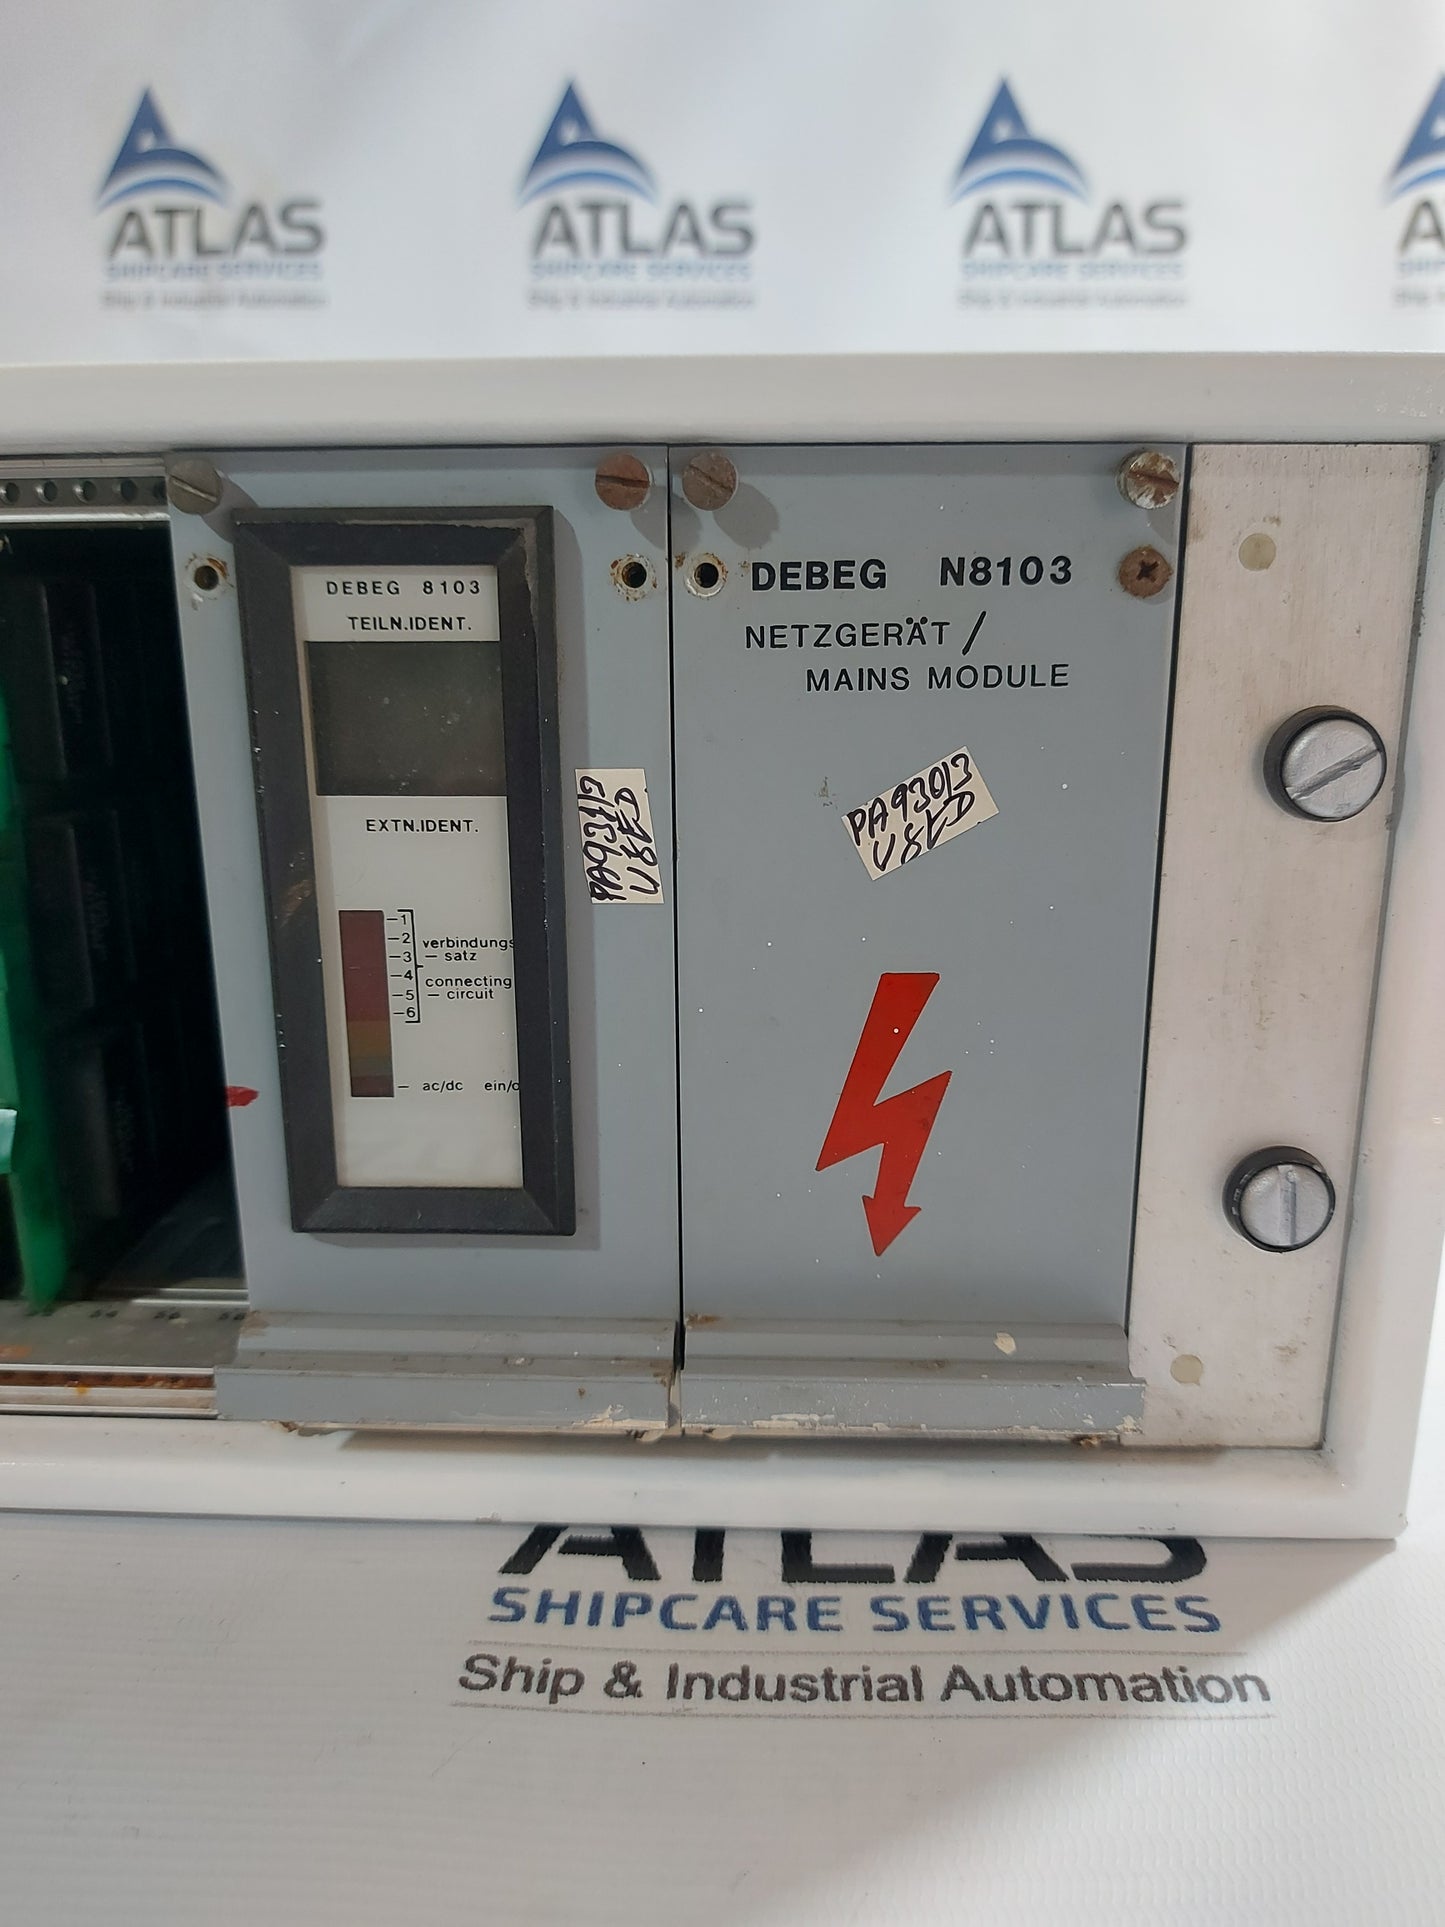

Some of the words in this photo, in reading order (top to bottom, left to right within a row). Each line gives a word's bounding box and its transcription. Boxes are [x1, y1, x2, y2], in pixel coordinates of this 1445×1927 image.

[108, 202, 323, 256] ATLAS
[533, 202, 754, 255] ATLAS
[963, 202, 1187, 255] ATLAS
[752, 560, 887, 592] DEBEG
[940, 556, 1072, 586] N8103
[326, 580, 400, 596] DEBEG
[422, 580, 481, 595] 8103
[745, 617, 951, 649] NETZGERÄT
[806, 667, 910, 692] MAINS
[928, 664, 1069, 689] MODULE
[366, 819, 479, 833] EXTN.IDENT.
[401, 914, 407, 925] 1
[402, 933, 411, 944] 2
[403, 951, 412, 962] 3
[444, 951, 477, 961] satz
[404, 970, 413, 981] 4
[425, 976, 512, 989] connecting
[406, 990, 415, 1001] 5
[447, 988, 494, 1000] circuit
[406, 1007, 416, 1018] 6
[422, 1080, 464, 1093] ac/dc
[488, 1586, 843, 1632] SHIPCARE
[870, 1593, 1222, 1633] SERVICES
[458, 1653, 586, 1704] Ship
[603, 1660, 643, 1699] &
[666, 1662, 924, 1702] Industrial
[940, 1664, 1271, 1703] Automation
